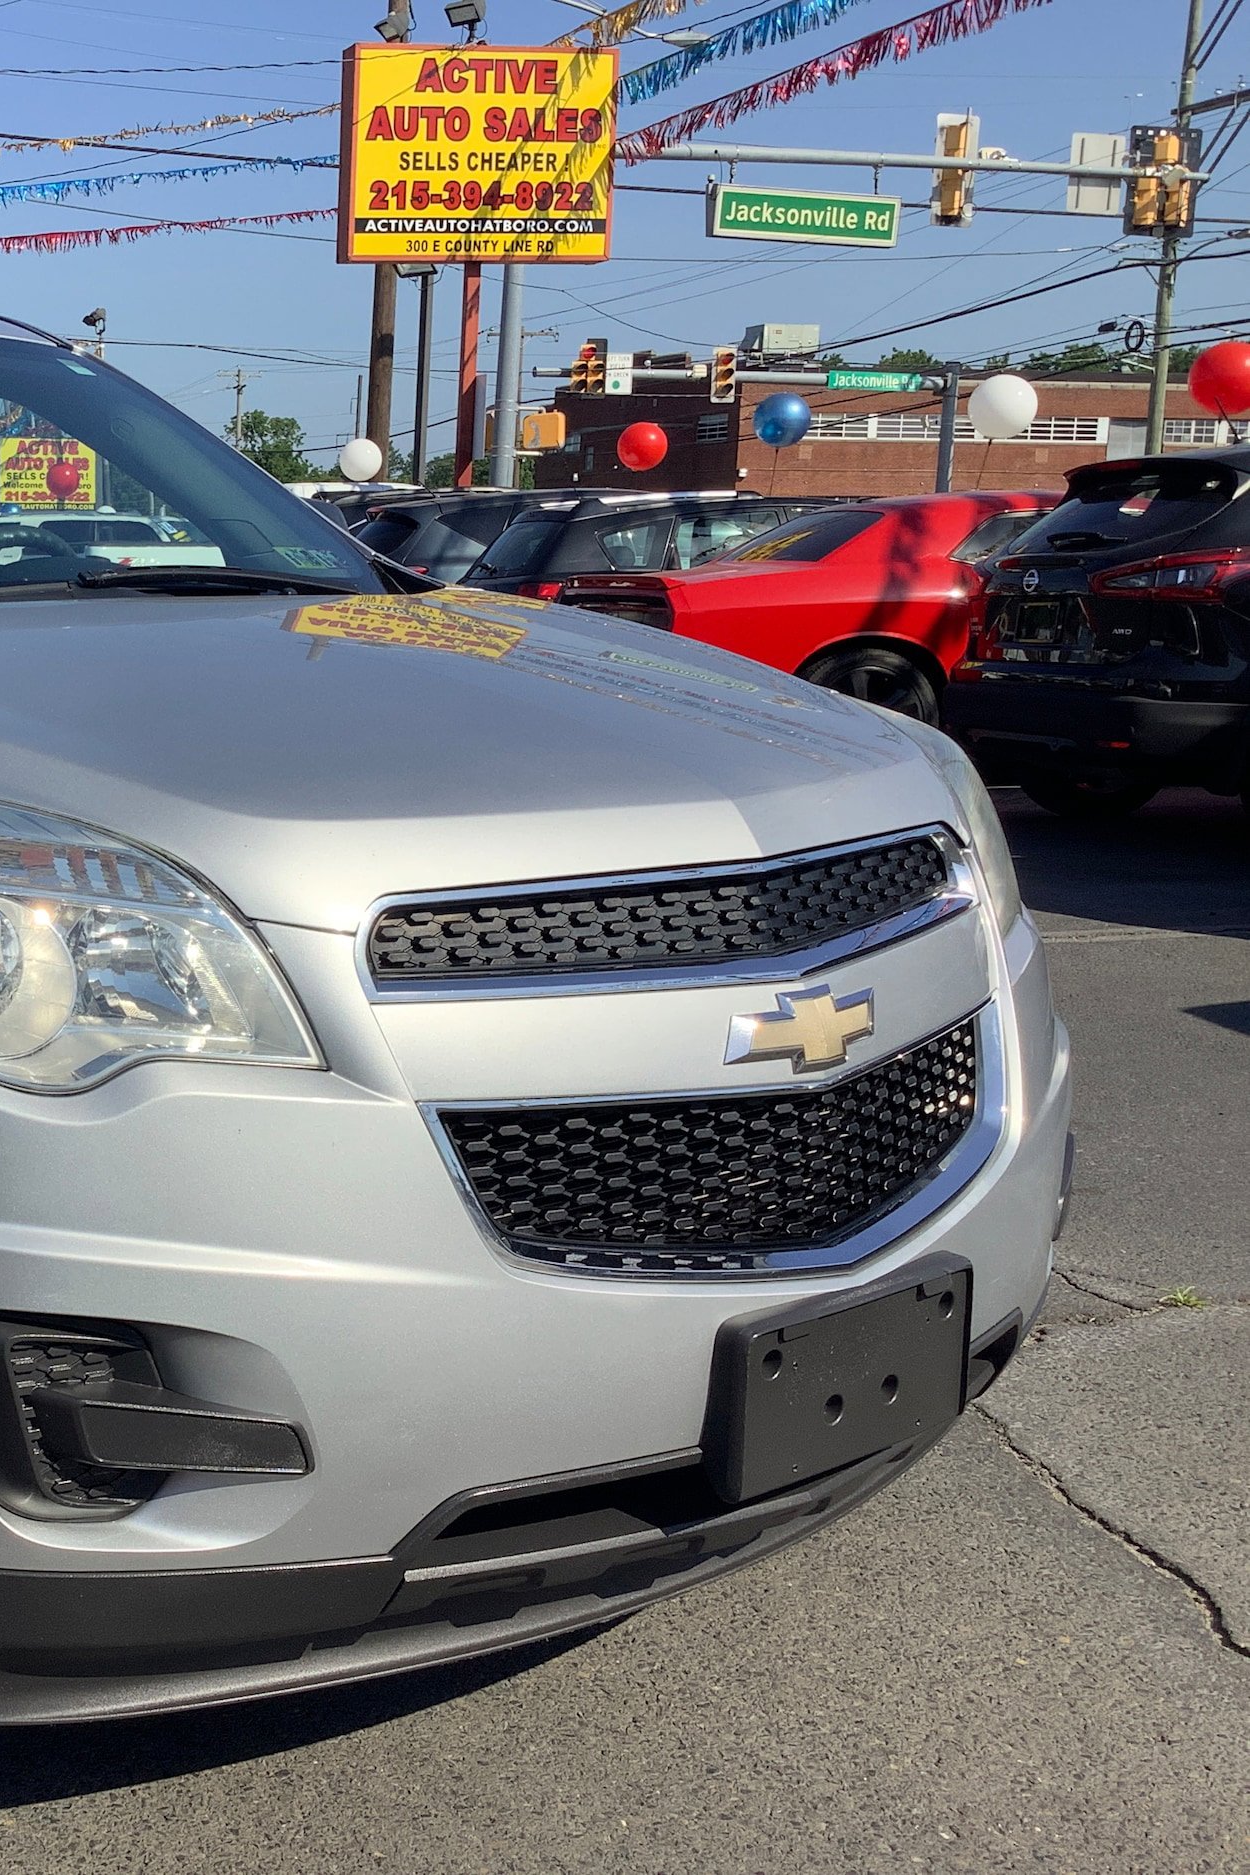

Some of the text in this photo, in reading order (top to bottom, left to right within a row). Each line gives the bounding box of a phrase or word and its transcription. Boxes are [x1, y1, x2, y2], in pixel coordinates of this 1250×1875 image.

[414, 58, 558, 94] ACTIVE
[365, 106, 602, 143] AUTO SALES
[399, 151, 459, 171] SELLS
[369, 180, 593, 211] 215-394-8922
[725, 201, 890, 232] Jacksonville Rd
[364, 218, 593, 233] ACTIVEAUTOHATBORO.COM
[406, 240, 554, 253] 300 E COUNTY LINE RD
[833, 373, 899, 389] Jacksonville
[17, 440, 79, 455] ACTIVE
[5, 457, 90, 470] AUTO SES
[6, 472, 37, 480] SELLS
[3, 481, 44, 489] Welcome
